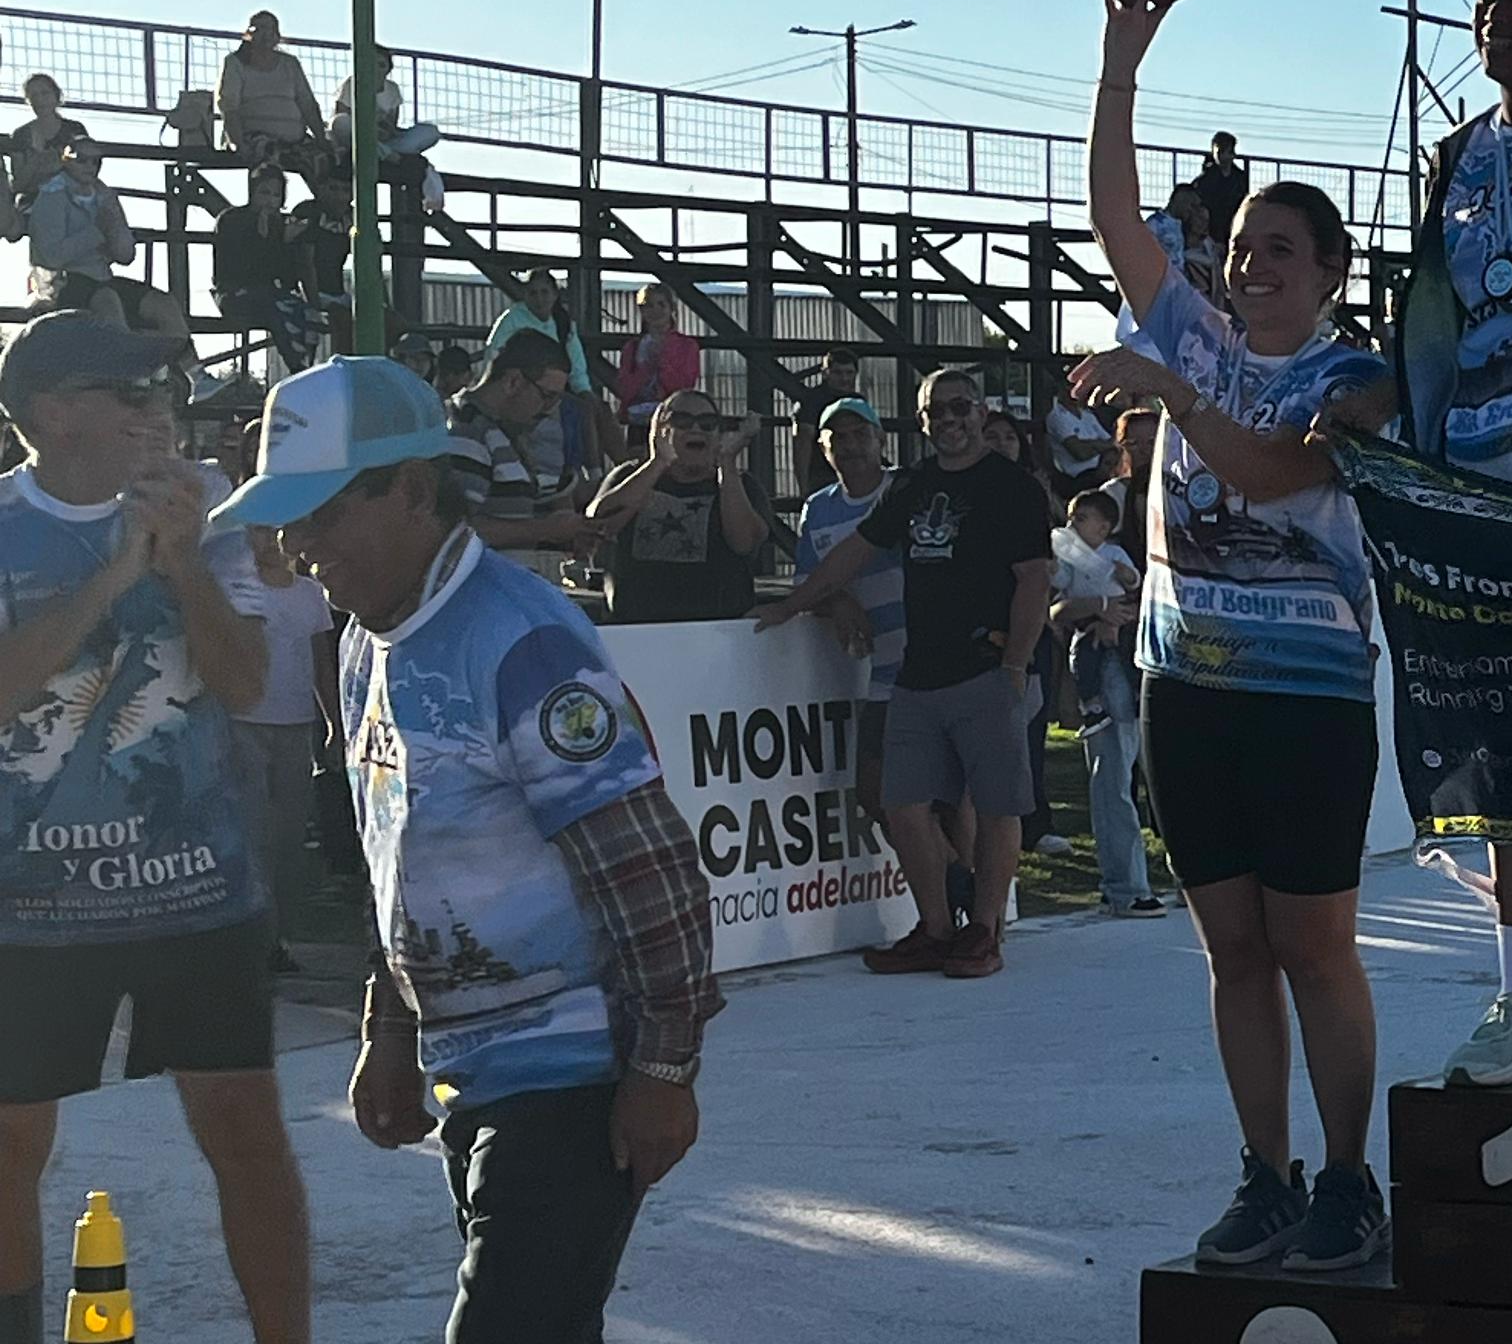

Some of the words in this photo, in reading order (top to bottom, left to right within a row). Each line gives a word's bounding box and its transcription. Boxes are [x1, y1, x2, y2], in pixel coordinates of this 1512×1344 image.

[1221, 587, 1337, 622] Belgrano
[690, 700, 852, 789] MONT
[699, 786, 881, 879] CASER
[62, 858, 80, 881] y
[89, 841, 217, 891] Gloria
[787, 859, 908, 914] adelante
